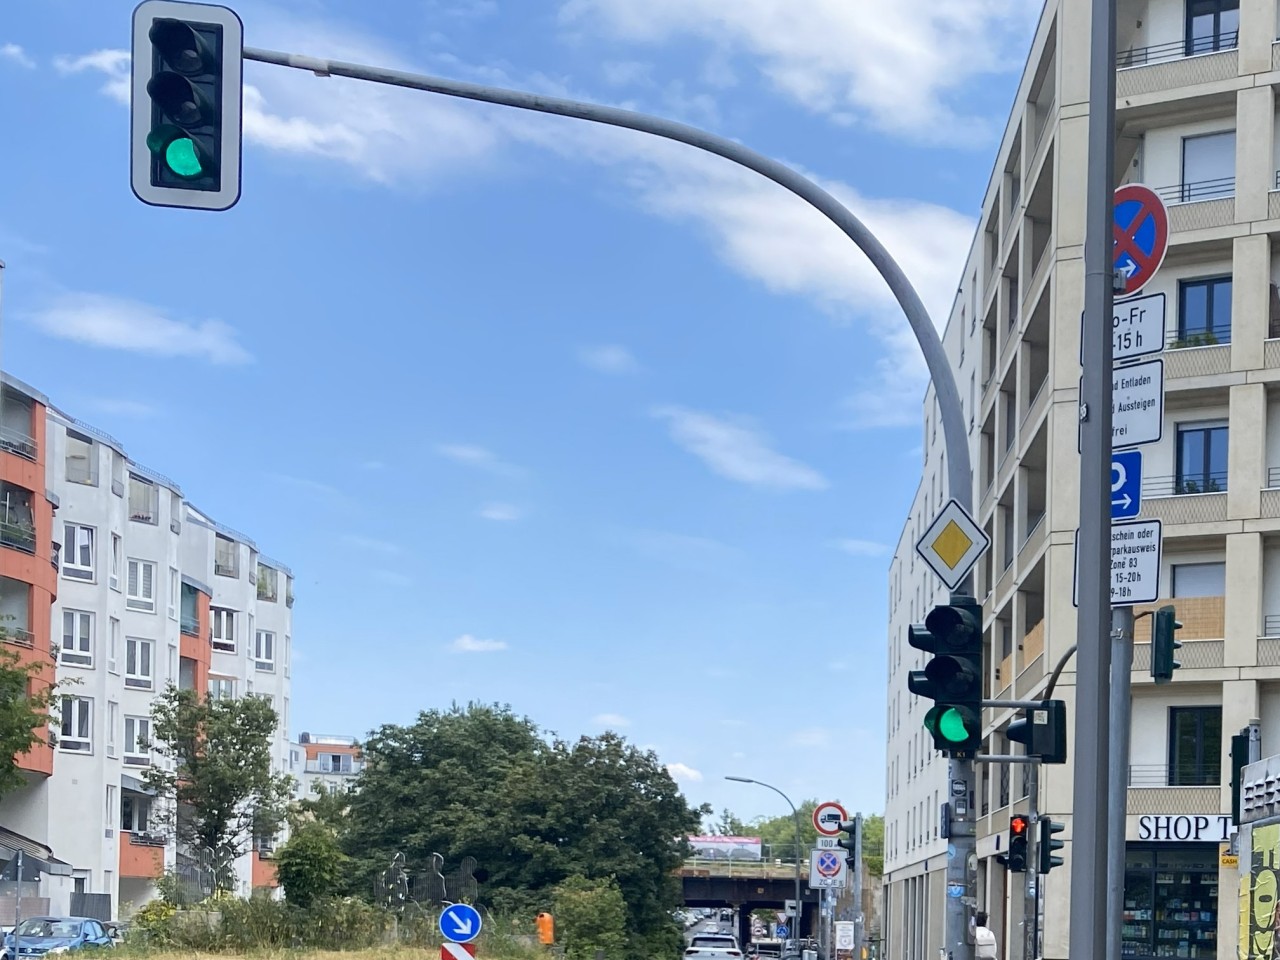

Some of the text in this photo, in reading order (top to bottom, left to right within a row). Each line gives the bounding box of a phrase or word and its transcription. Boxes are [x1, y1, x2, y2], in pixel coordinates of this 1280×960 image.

[1113, 306, 1147, 329] o-Fr
[1113, 332, 1132, 351] -15
[1121, 374, 1151, 390] Entladen
[1118, 397, 1156, 413] Aussteigen
[1112, 528, 1154, 541] schein oder
[1111, 542, 1156, 558] parkausweis
[1129, 557, 1138, 568] 83
[1139, 815, 1209, 840] SHOP
[821, 839, 833, 848] 100
